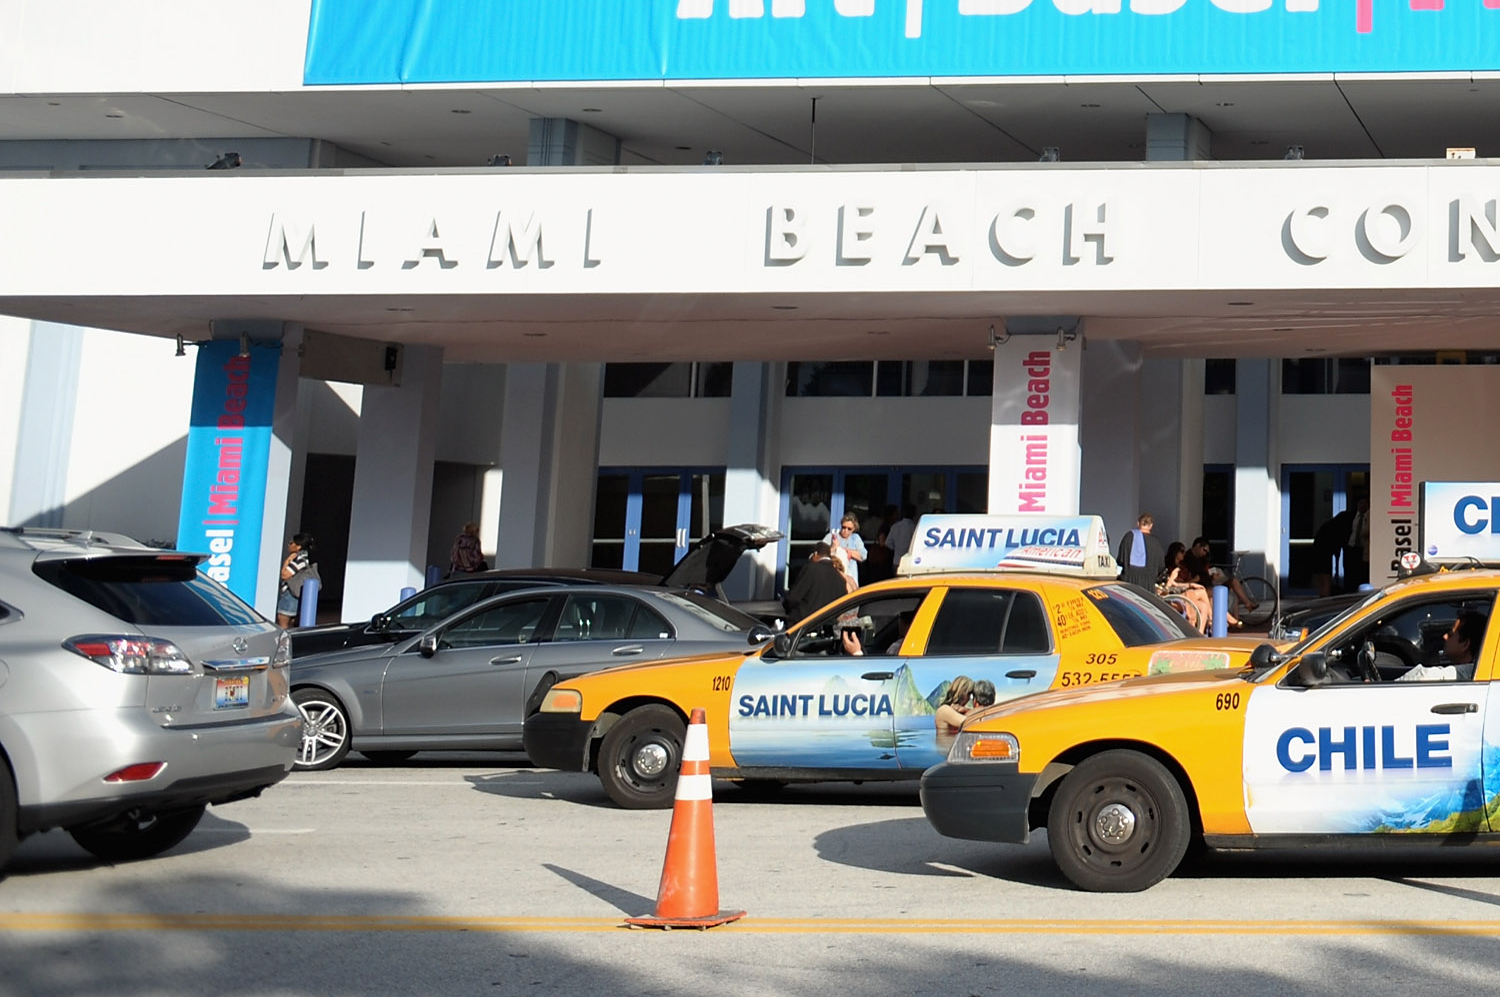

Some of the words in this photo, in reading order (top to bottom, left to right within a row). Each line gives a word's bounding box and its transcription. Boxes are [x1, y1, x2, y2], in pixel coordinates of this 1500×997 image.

[262, 209, 604, 271] MIAMI
[764, 202, 1119, 268] BEACH
[217, 355, 252, 430] Beach
[1021, 351, 1052, 426] Beach
[1391, 385, 1412, 442] Beach
[207, 437, 243, 515] Miami
[1018, 435, 1048, 512] Miami
[1391, 448, 1412, 506] Miami
[206, 529, 235, 588] asel
[924, 528, 1003, 548] SAINT
[1005, 528, 1081, 548] LUCIA
[1023, 546, 1082, 559] American
[1098, 555, 1110, 568] TAXI
[712, 675, 731, 691] 1210
[1061, 671, 1143, 687] 532-5
[1085, 653, 1118, 665] 305
[738, 694, 814, 717] SAINT
[818, 693, 895, 716] LUCIA
[1216, 692, 1240, 710] 690
[1276, 723, 1453, 773] CHILE
